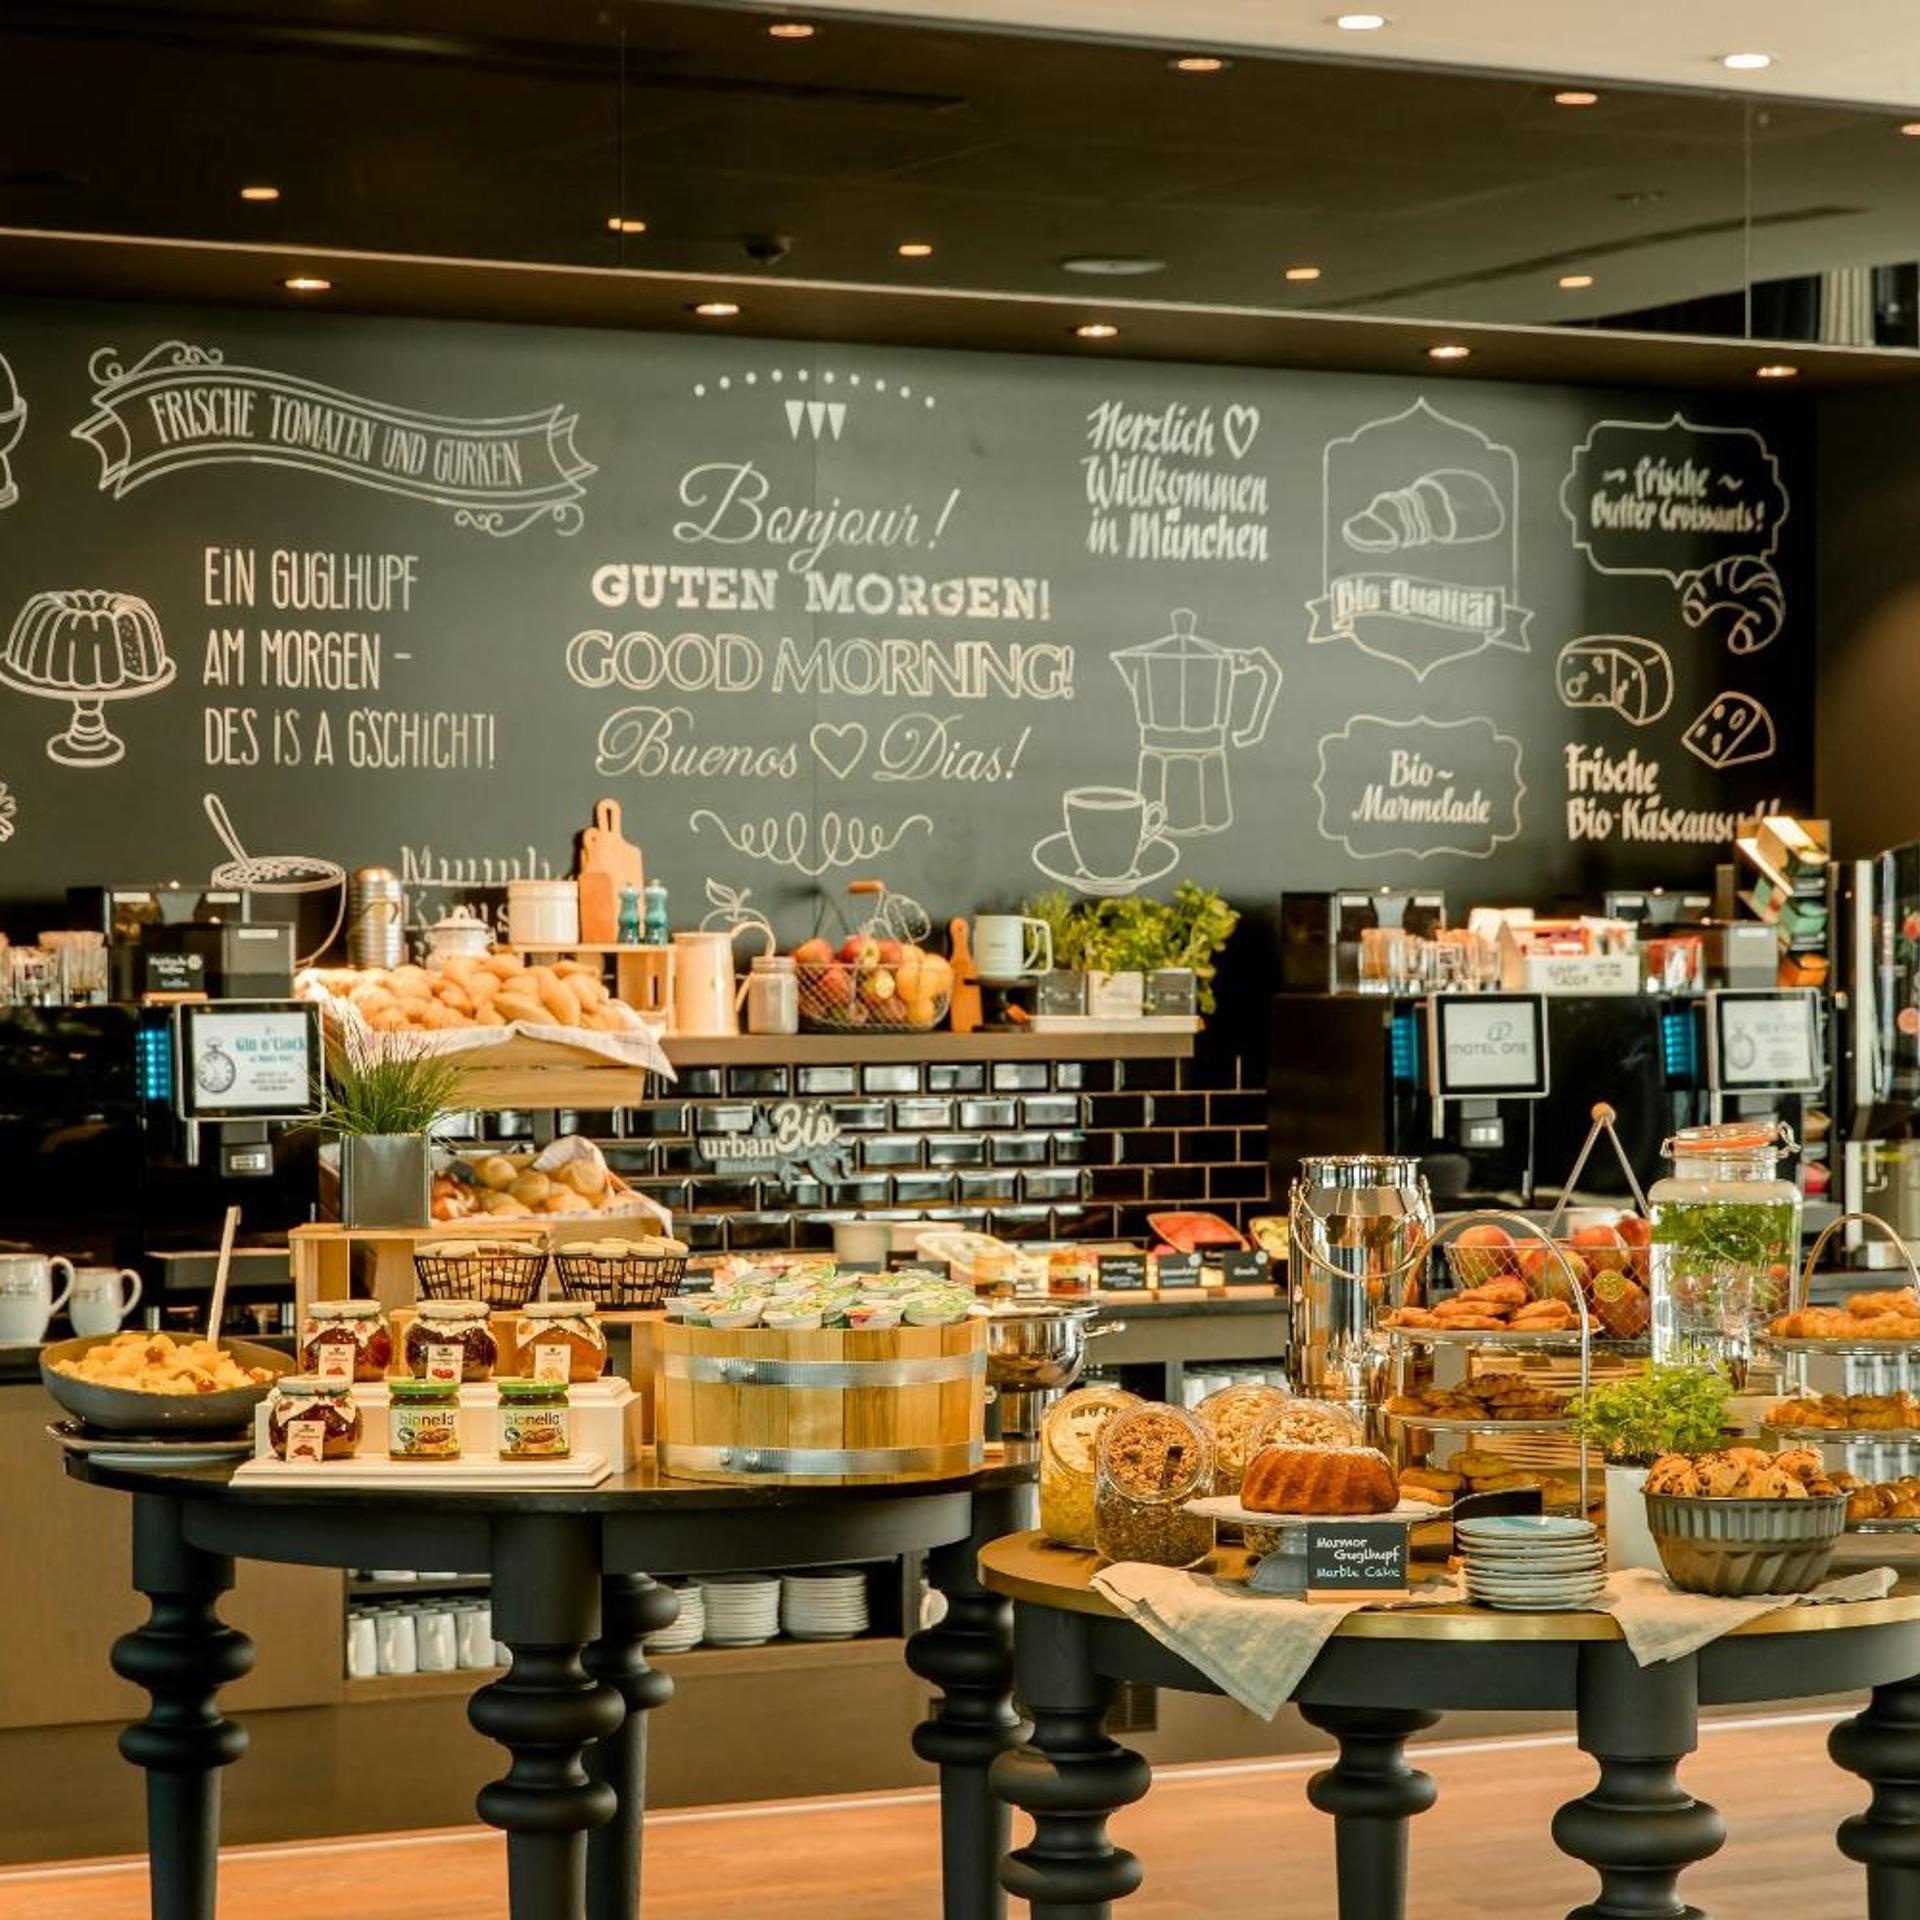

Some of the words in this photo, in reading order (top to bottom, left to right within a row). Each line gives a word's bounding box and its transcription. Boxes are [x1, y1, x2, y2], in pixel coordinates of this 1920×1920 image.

[149, 387, 256, 444] FRISCHE
[269, 395, 377, 462] TOMATEN
[381, 426, 427, 476] UND
[433, 439, 523, 486] GURKEN
[1086, 400, 1214, 458] Herzlich
[1080, 450, 1269, 515] Willkommen
[1086, 506, 1119, 555] in
[1126, 506, 1268, 562] München
[272, 550, 419, 612] GUGLHUPF
[591, 564, 778, 610] GUTEN
[805, 570, 1051, 620] MORGEN!
[203, 629, 245, 686] AM
[261, 629, 380, 690] MORGEN
[566, 629, 763, 692] GOOD
[772, 636, 1075, 699] MORNING!
[205, 707, 259, 766] DES
[314, 710, 335, 766] A
[596, 706, 798, 777] Buenos
[871, 712, 1032, 782] Dias!
[1564, 742, 1659, 794] Frische
[1351, 783, 1490, 824] Marmelade
[1316, 1537, 1368, 1548] Marmor
[1334, 1545, 1400, 1566] Guglhupf
[1364, 1566, 1400, 1578] Cake
